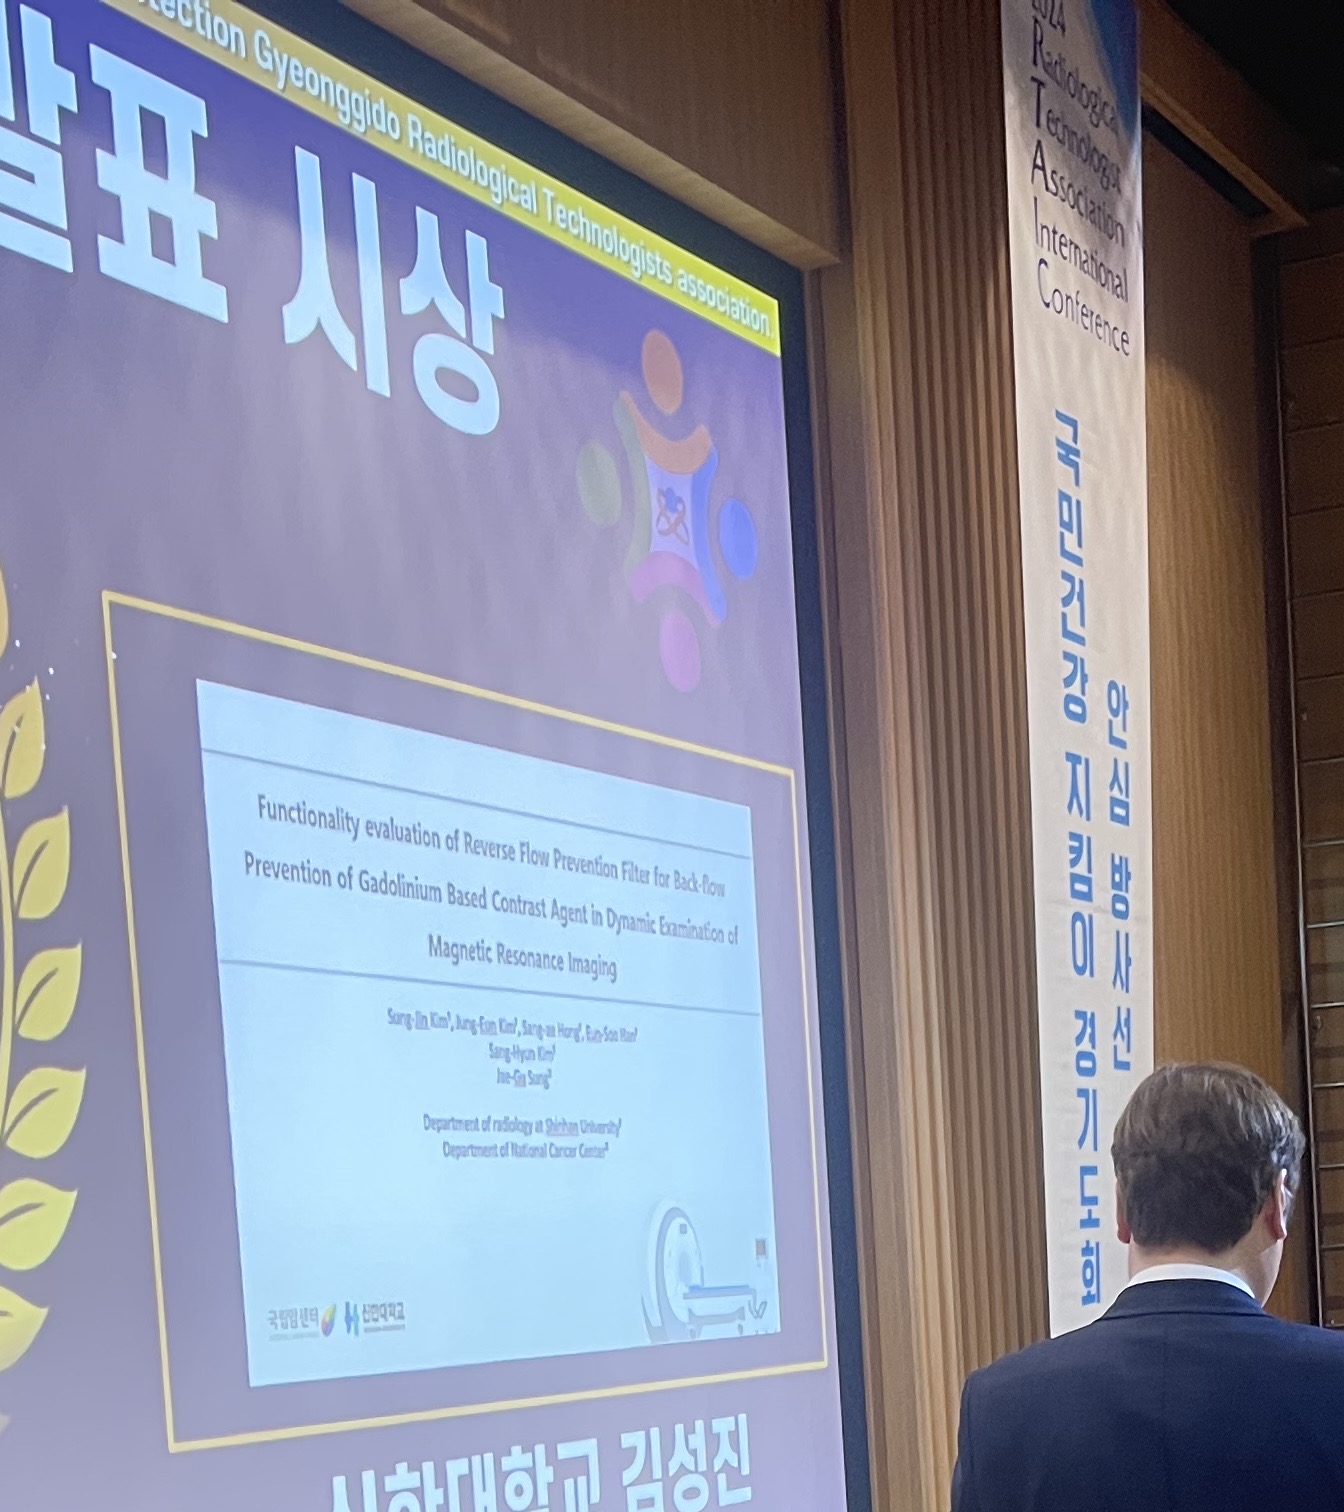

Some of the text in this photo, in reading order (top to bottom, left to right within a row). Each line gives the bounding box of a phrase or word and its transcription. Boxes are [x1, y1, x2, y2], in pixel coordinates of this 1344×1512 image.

[138, 0, 247, 58] ection
[254, 29, 401, 141] Gyeonggido
[407, 113, 538, 213] Radiological
[543, 187, 674, 285] Technologists
[1031, 139, 1125, 248] Association
[282, 145, 505, 436] 시상
[1033, 196, 1129, 303] International
[1037, 257, 1130, 357] Conference
[244, 850, 739, 946] Prevention of Gadolinium Based Contrast Agent in Dynamic Examination of
[258, 793, 726, 898] Functionality evaluation of Reverse Flow Prevention Filter for Back-flow
[1054, 408, 1102, 1307] 국민건강 지킴이 경기도회
[428, 933, 618, 984] Magnetic Resonance Imaging
[423, 1113, 479, 1134] Department
[481, 1115, 491, 1132] of
[442, 1141, 499, 1160] Department
[500, 1141, 510, 1158] of
[511, 1141, 547, 1158] National
